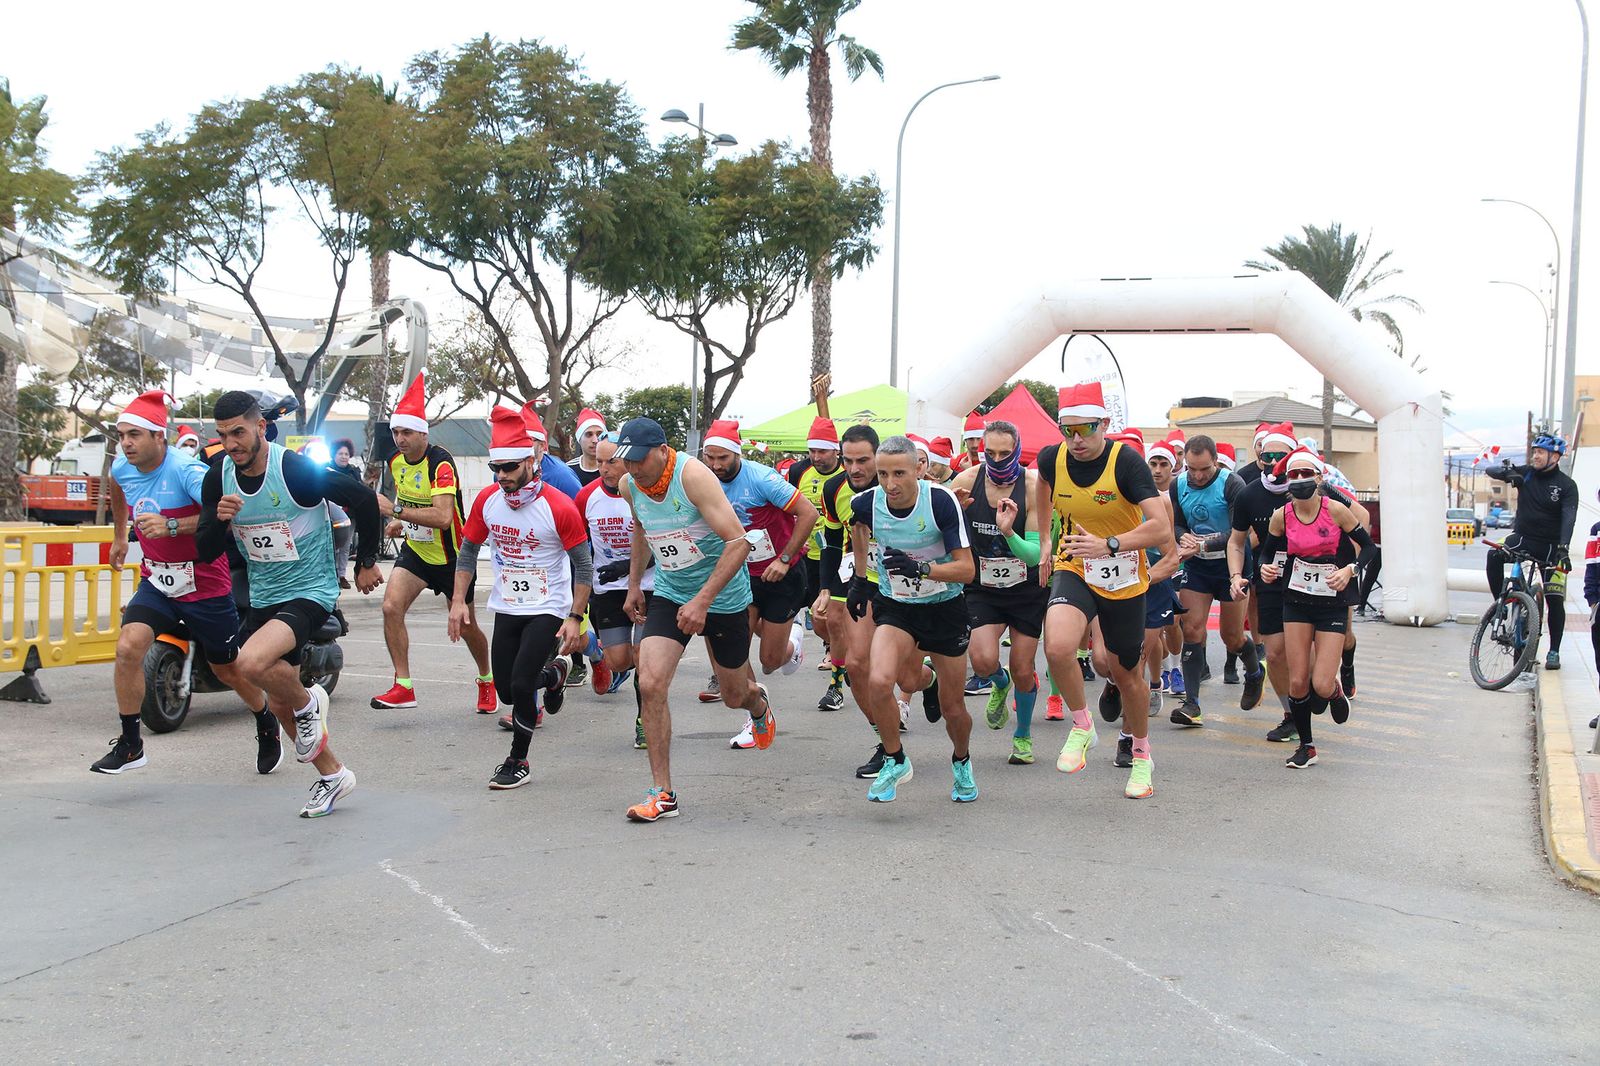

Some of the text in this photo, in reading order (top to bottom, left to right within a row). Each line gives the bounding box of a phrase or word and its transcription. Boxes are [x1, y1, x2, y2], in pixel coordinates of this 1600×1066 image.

[607, 517, 624, 525] SAN
[490, 523, 520, 537] XII SAN
[252, 536, 274, 548] 62
[659, 544, 679, 558] 59
[992, 568, 1011, 578] 32
[1100, 565, 1120, 579] 31
[1303, 572, 1320, 583] 51
[158, 574, 175, 587] 40
[512, 580, 530, 592] 33
